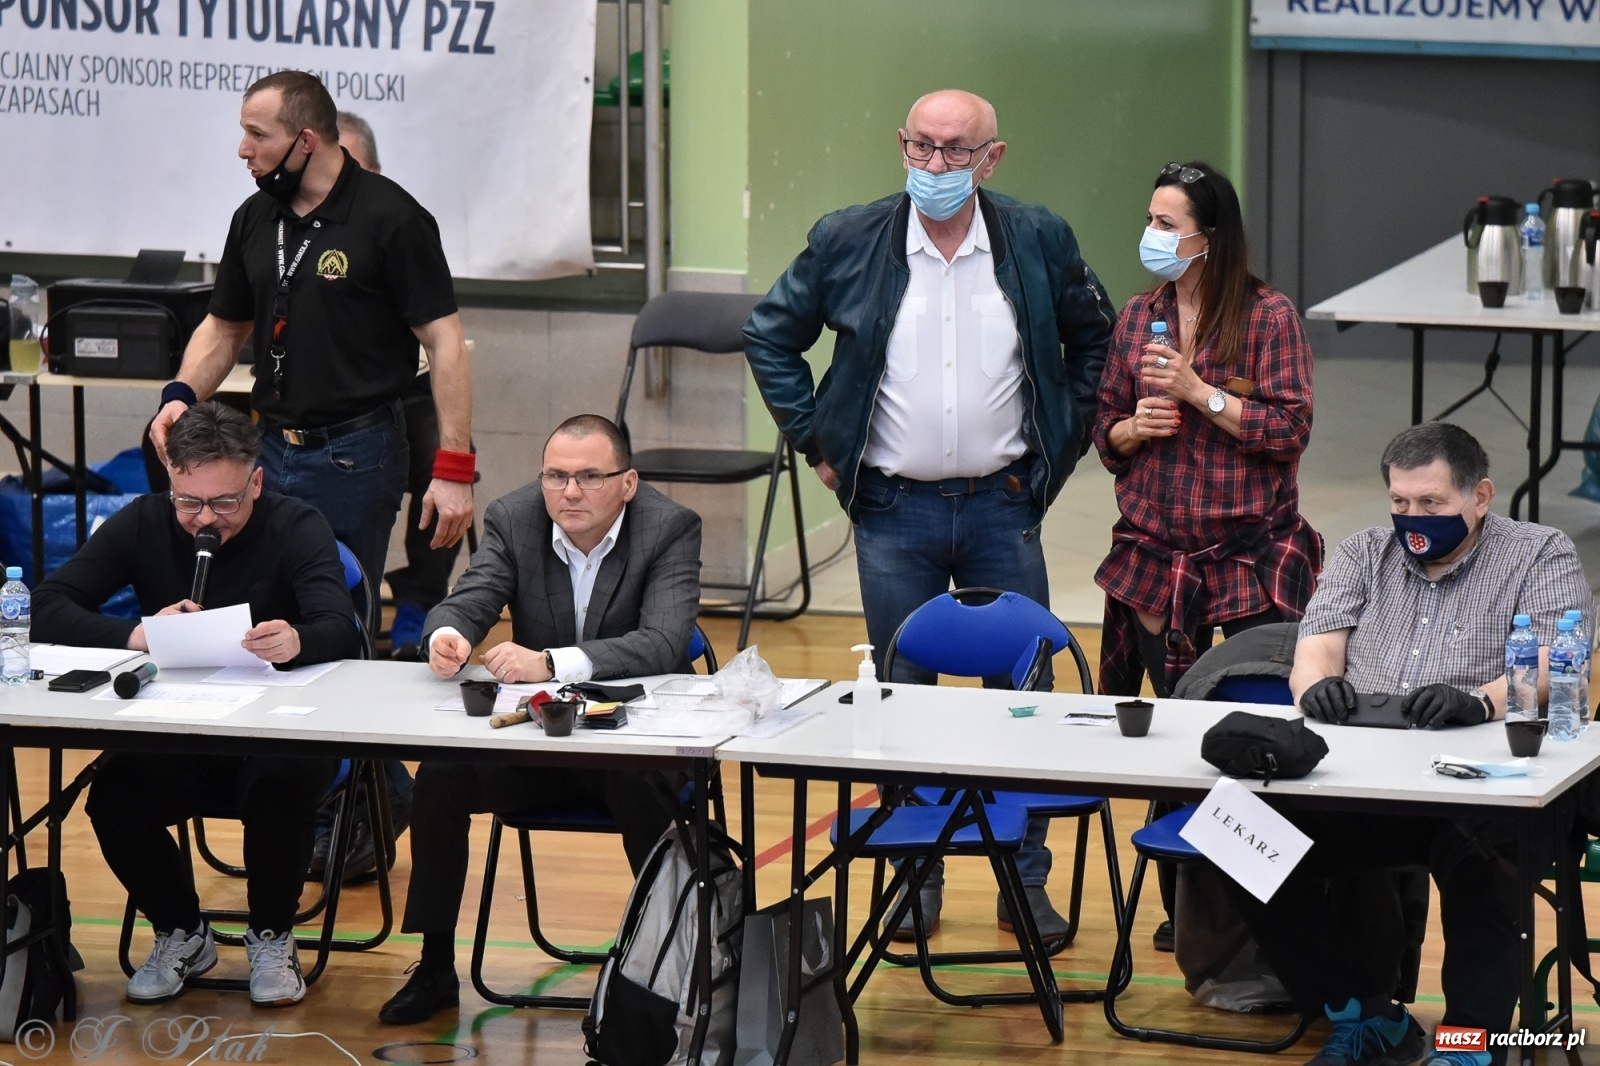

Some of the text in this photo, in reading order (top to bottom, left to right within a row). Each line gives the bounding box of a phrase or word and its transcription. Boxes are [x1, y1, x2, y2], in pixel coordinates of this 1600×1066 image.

[423, 0, 496, 54] PZZ
[0, 51, 74, 81] CJALNY
[80, 55, 173, 87] SPONSOR
[336, 71, 405, 102] POLSKI
[1212, 807, 1280, 863] LEKARZ
